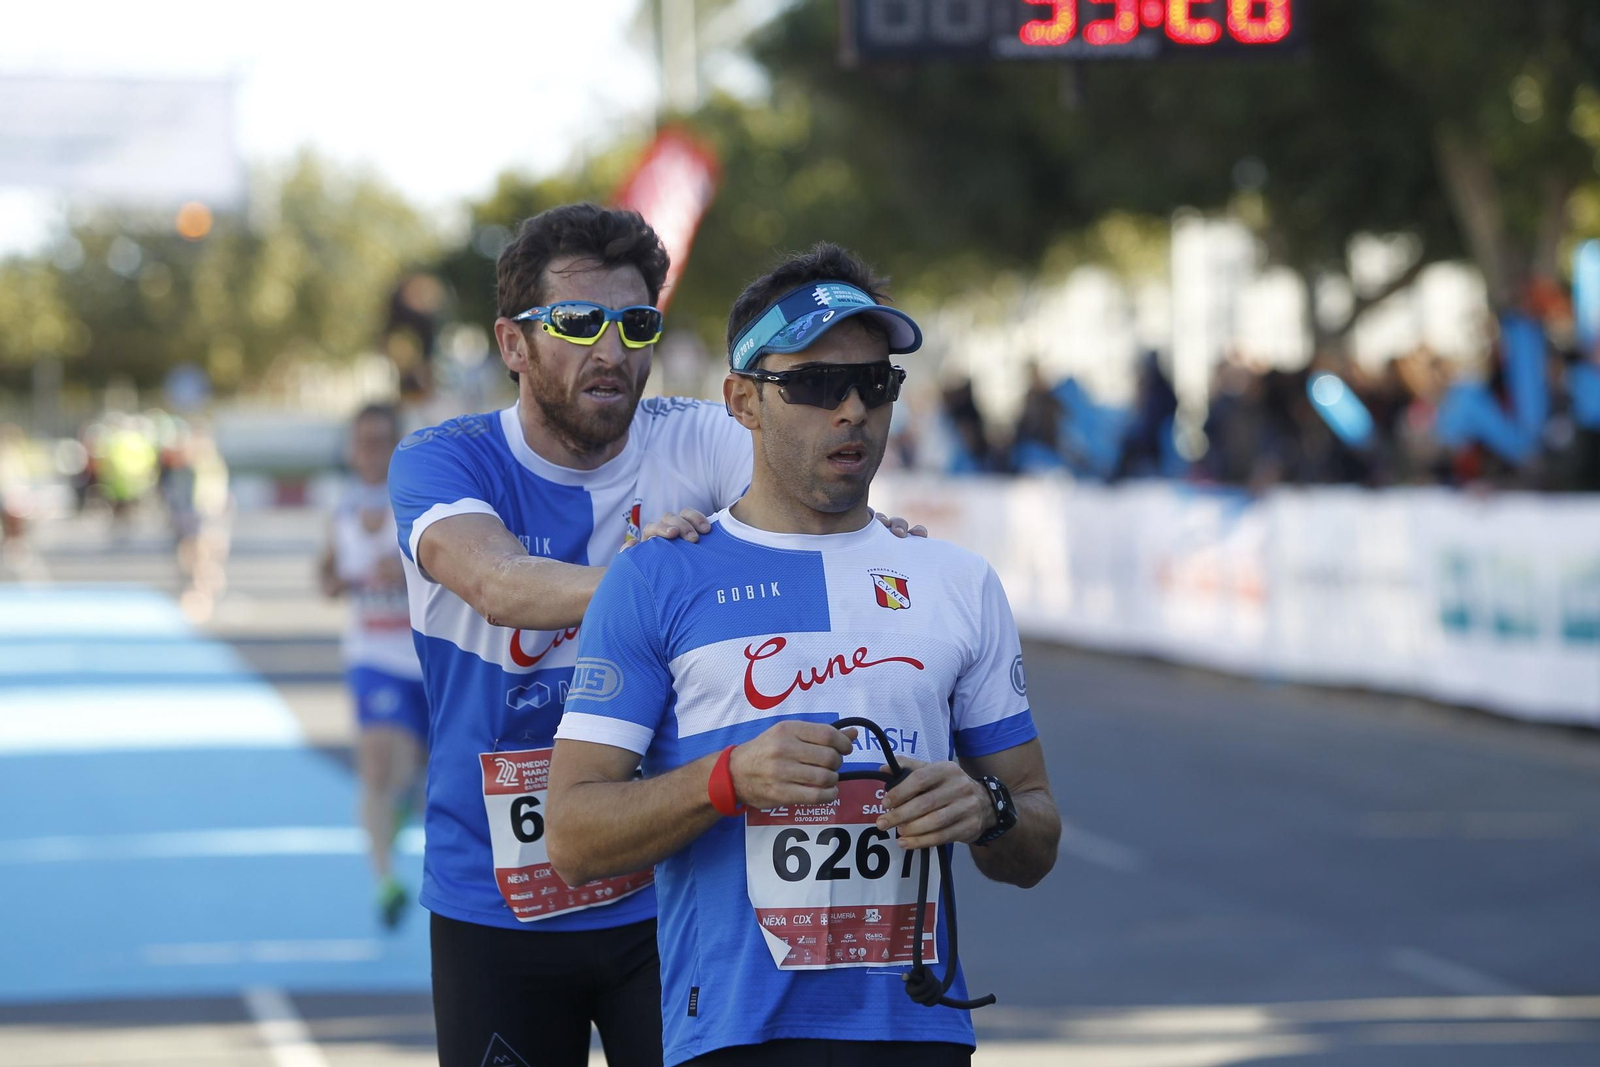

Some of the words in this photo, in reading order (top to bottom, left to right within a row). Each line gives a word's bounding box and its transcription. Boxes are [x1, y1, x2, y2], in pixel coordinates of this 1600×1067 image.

[740, 338, 755, 356] 2018
[716, 582, 781, 604] GOBIK
[743, 636, 925, 711] Cune
[521, 760, 550, 769] MEDIO
[522, 768, 550, 777] MARA
[524, 776, 548, 786] ALME
[794, 805, 836, 816] ALMERÍA
[862, 804, 890, 815] SAL
[510, 795, 545, 843] 6
[507, 873, 530, 884] NEXA
[762, 915, 787, 926] NEXA
[792, 913, 814, 925] CDX
